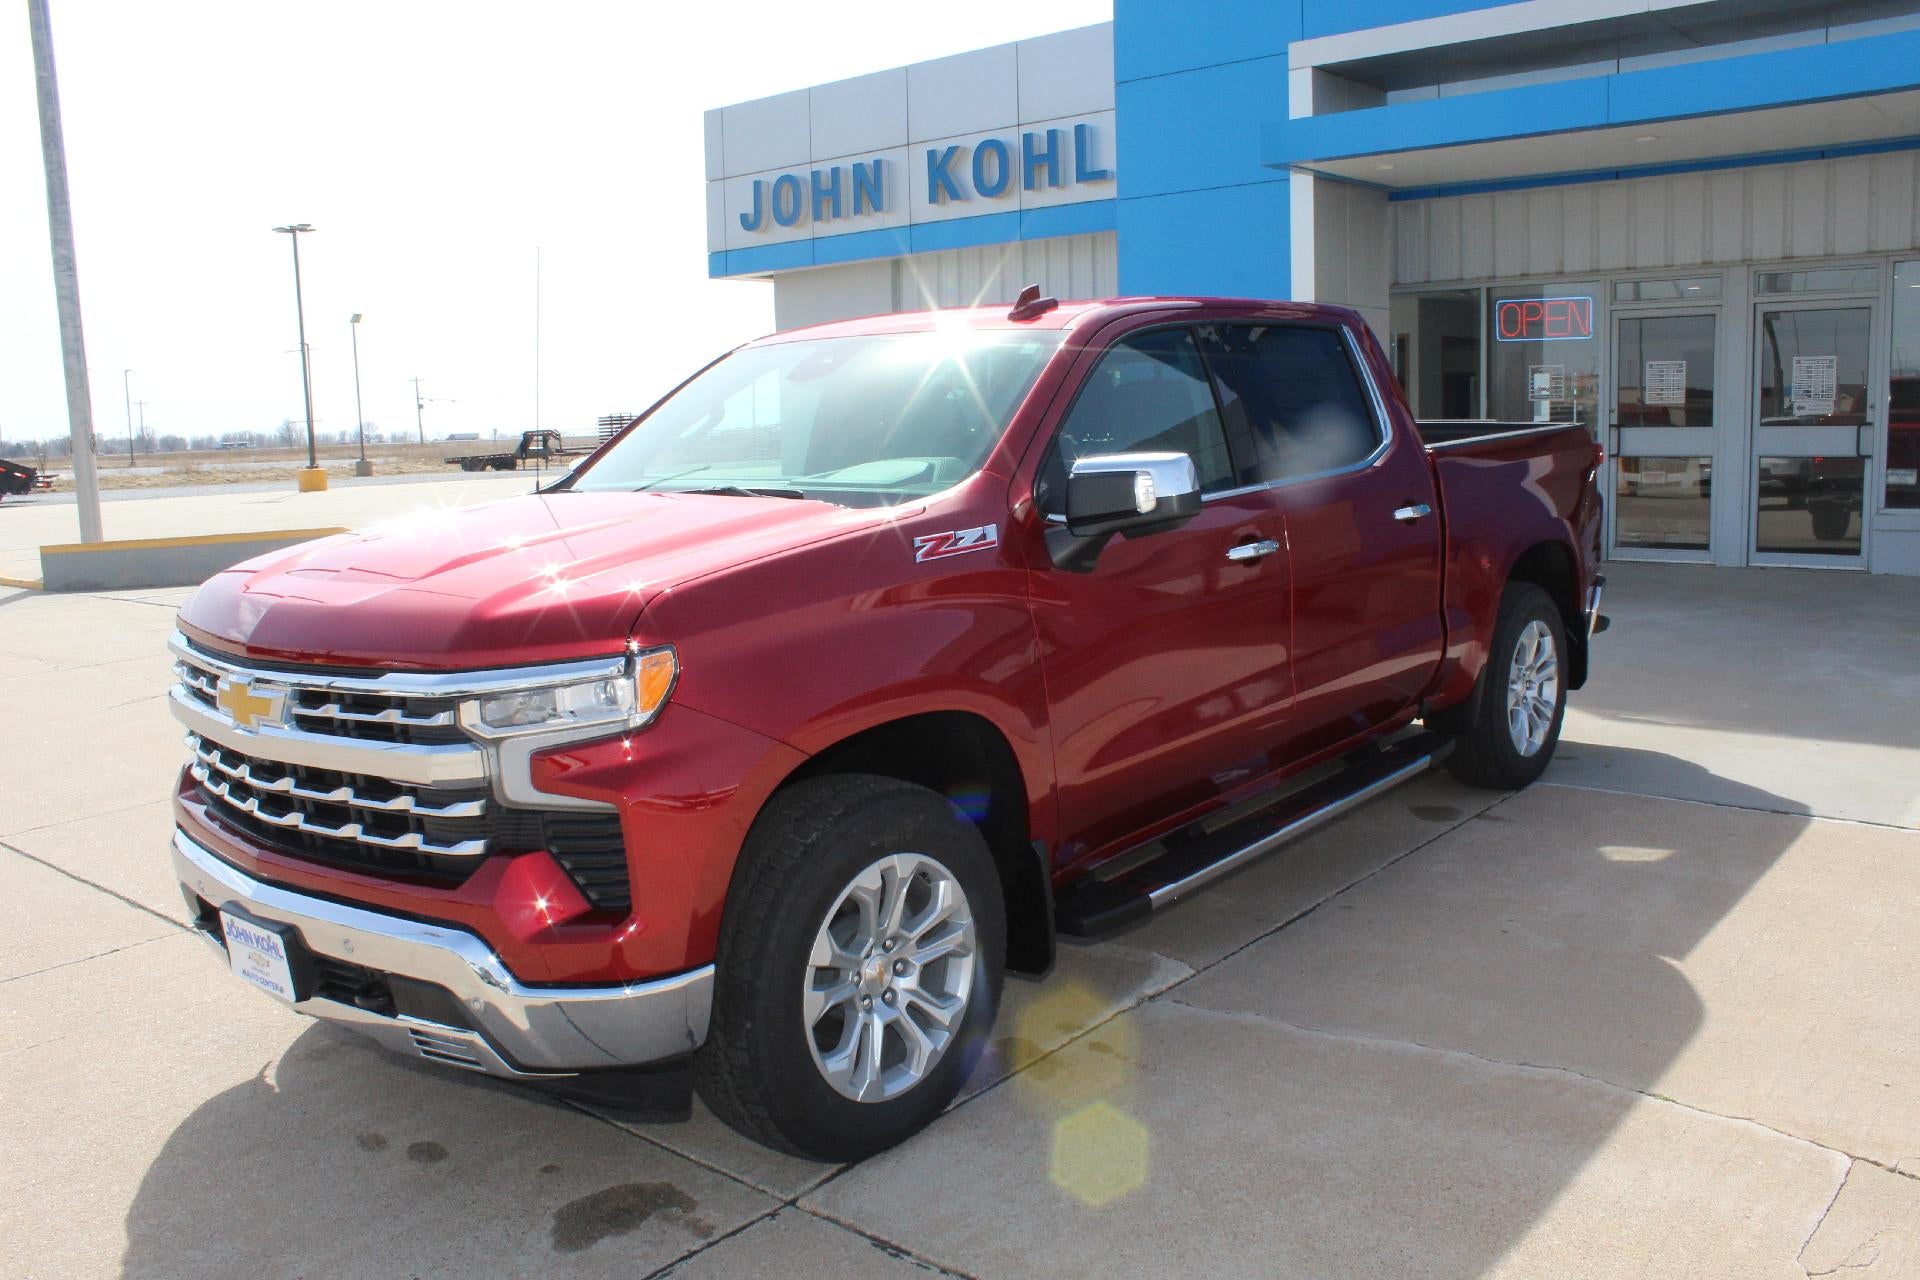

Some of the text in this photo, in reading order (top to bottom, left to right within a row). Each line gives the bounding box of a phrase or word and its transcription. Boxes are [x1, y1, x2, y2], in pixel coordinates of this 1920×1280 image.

[739, 124, 1115, 232] JOHN KOHL
[1500, 301, 1589, 337] OPEN
[913, 523, 998, 563] Z71
[226, 920, 285, 960] JOHN KOHL
